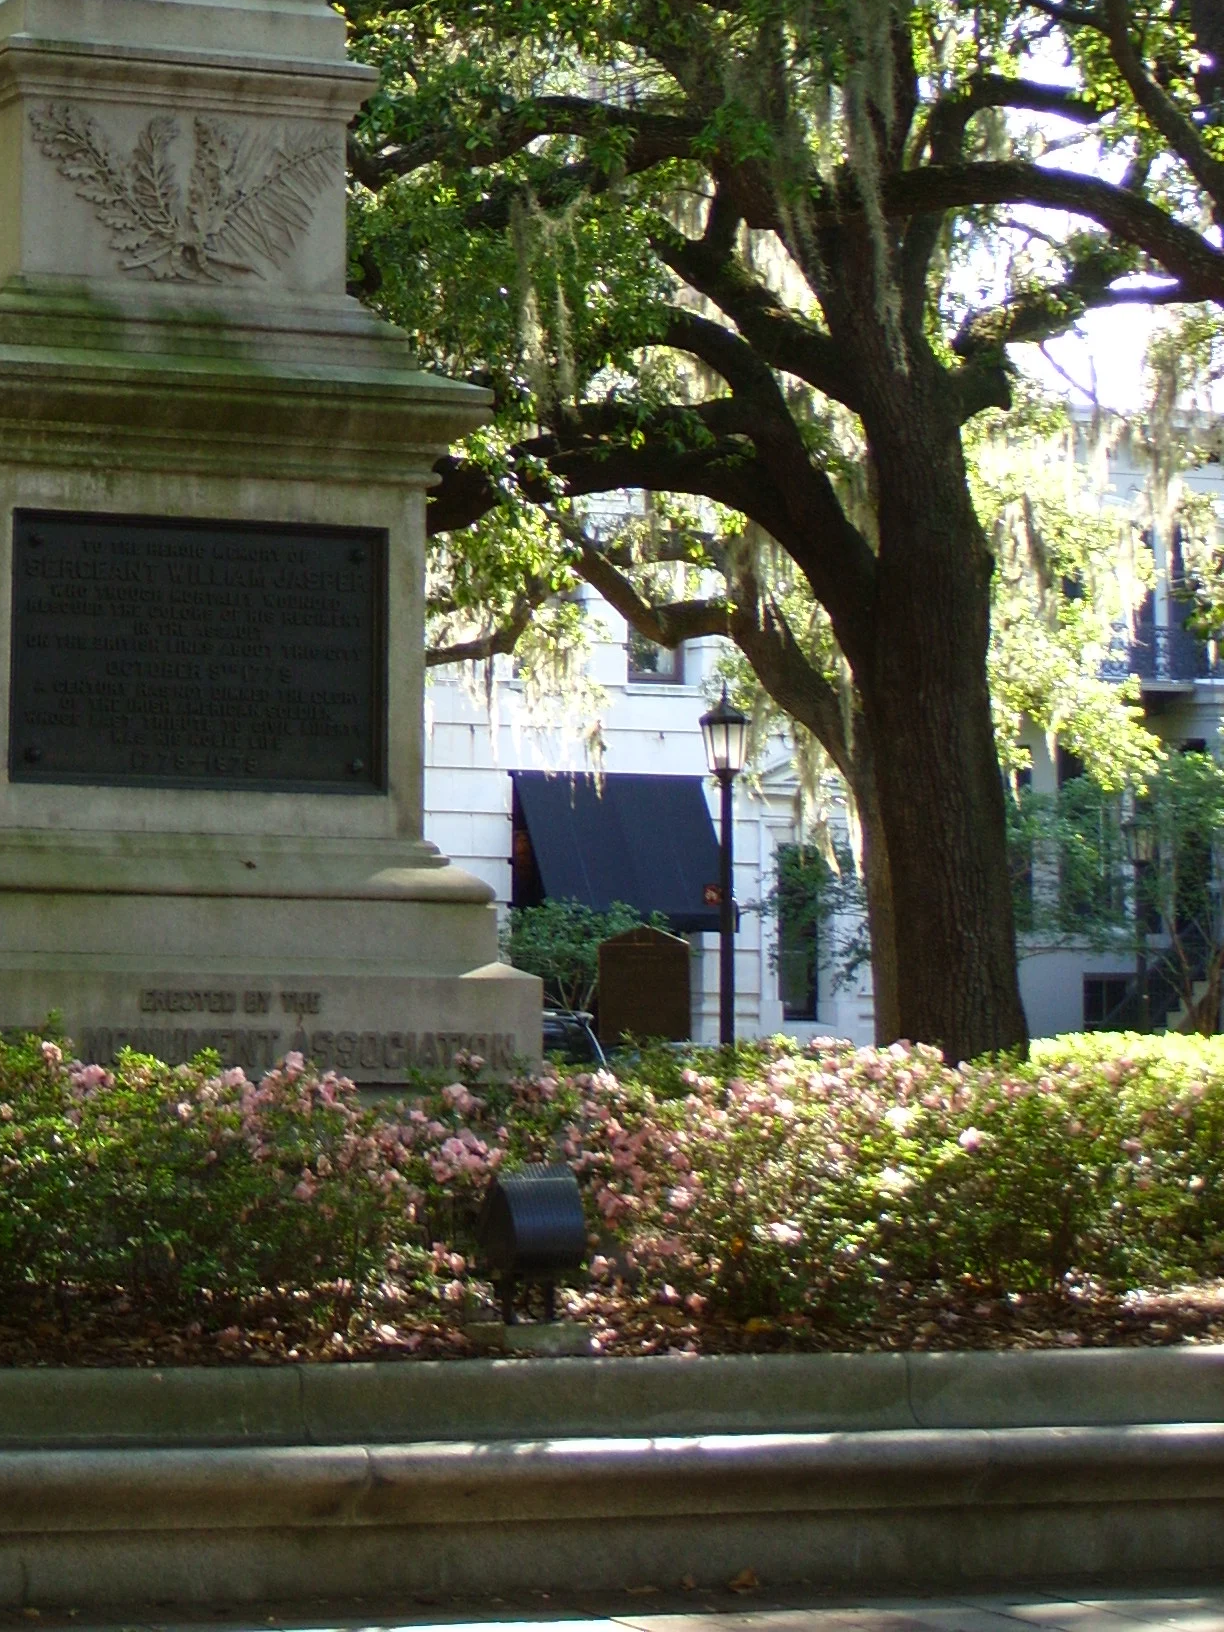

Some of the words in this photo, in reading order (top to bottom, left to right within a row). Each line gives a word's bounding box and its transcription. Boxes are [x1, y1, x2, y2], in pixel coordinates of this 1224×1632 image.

[82, 539, 103, 554] TO
[111, 541, 141, 556] THE
[147, 542, 204, 559] HEROIC
[213, 544, 280, 563] MEMORY
[287, 549, 308, 564] OF
[23, 555, 161, 584] SERGEANT
[167, 563, 265, 589] WILLIAM
[273, 567, 369, 594] JASPER
[50, 583, 88, 599] WHO
[95, 585, 161, 602] THOUGH
[263, 593, 341, 612] WOUNDED
[27, 598, 104, 616] RESCUED
[110, 602, 142, 618] THE
[219, 609, 241, 623] OF
[247, 609, 275, 625] HIS
[282, 611, 361, 628] REGIMENT
[134, 622, 150, 637] IN
[156, 624, 187, 638] THE
[194, 626, 262, 642] ASSAULT
[26, 634, 49, 649] ON
[56, 635, 86, 651] THE
[92, 636, 160, 654] BRITISH
[167, 639, 214, 656] LINES
[219, 641, 272, 658] ABOUT
[281, 644, 321, 660] THIS
[325, 646, 361, 662] CITY
[106, 660, 200, 681] OCTOBER
[243, 664, 293, 684] 1779
[53, 679, 127, 696] CENTURY
[135, 683, 168, 699] HAS
[173, 685, 202, 700] NOT
[277, 689, 304, 704] THE
[310, 690, 359, 706] GLORY
[89, 697, 121, 713] THE
[128, 698, 170, 714] IRISH
[175, 699, 262, 718] AMERICAN
[143, 715, 211, 732] TRIBUTE
[222, 719, 241, 734] TO
[251, 721, 292, 736] CIVIL
[110, 730, 146, 745] WAS
[155, 732, 182, 747] HIS
[248, 736, 283, 752] LIFE
[140, 988, 236, 1013] ERECTED
[243, 990, 271, 1014] BY
[279, 990, 321, 1014] THE
